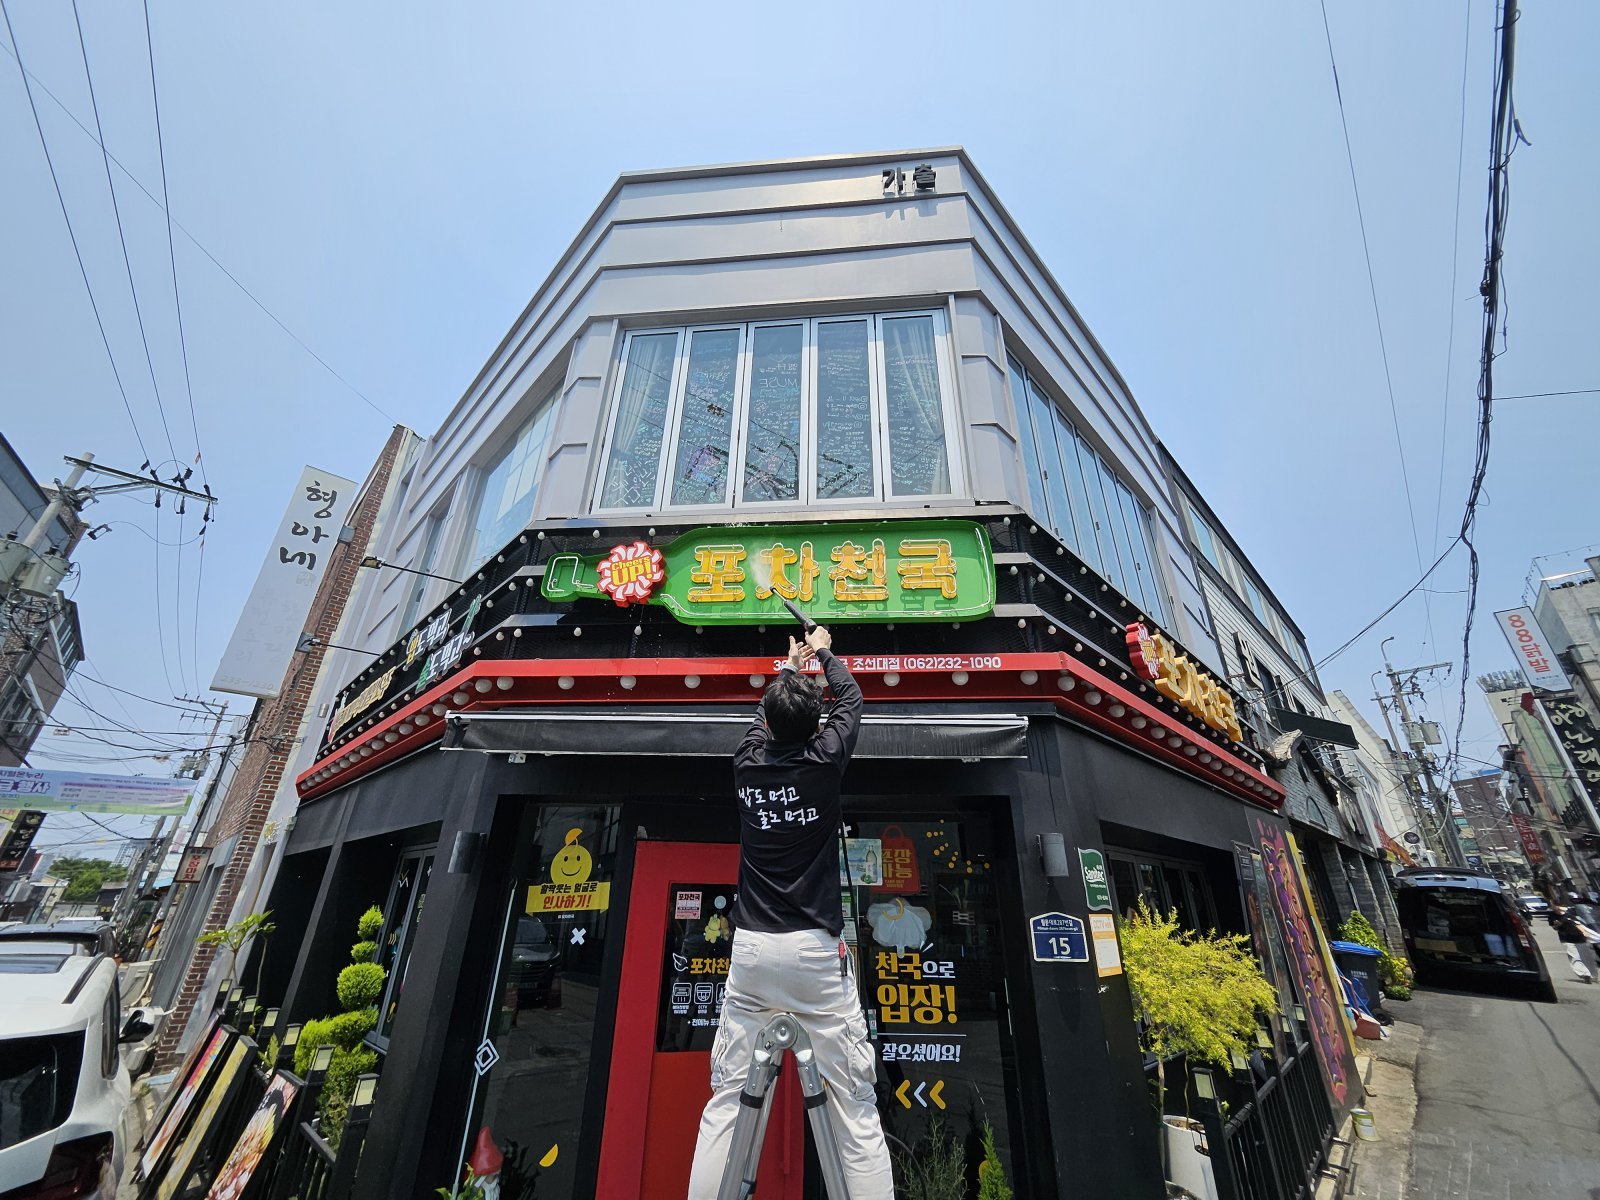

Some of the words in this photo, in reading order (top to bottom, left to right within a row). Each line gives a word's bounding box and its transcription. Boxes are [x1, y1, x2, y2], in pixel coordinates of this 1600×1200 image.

[611, 556, 651, 571] Cheers
[687, 538, 957, 602] 포차천국
[611, 561, 653, 586] UP!
[852, 657, 900, 671] 조선대점
[903, 656, 1002, 669] (062)232-1090
[739, 786, 766, 807] 밥도
[769, 786, 800, 805] 먹고
[784, 807, 819, 825] 먹고
[543, 894, 592, 909] 인사하기!
[1048, 937, 1071, 955] 15
[690, 957, 730, 975] 포차천
[875, 952, 956, 980] 천국으로
[877, 984, 958, 1024] 입장!
[882, 1043, 961, 1062] 잘오셨어요!
